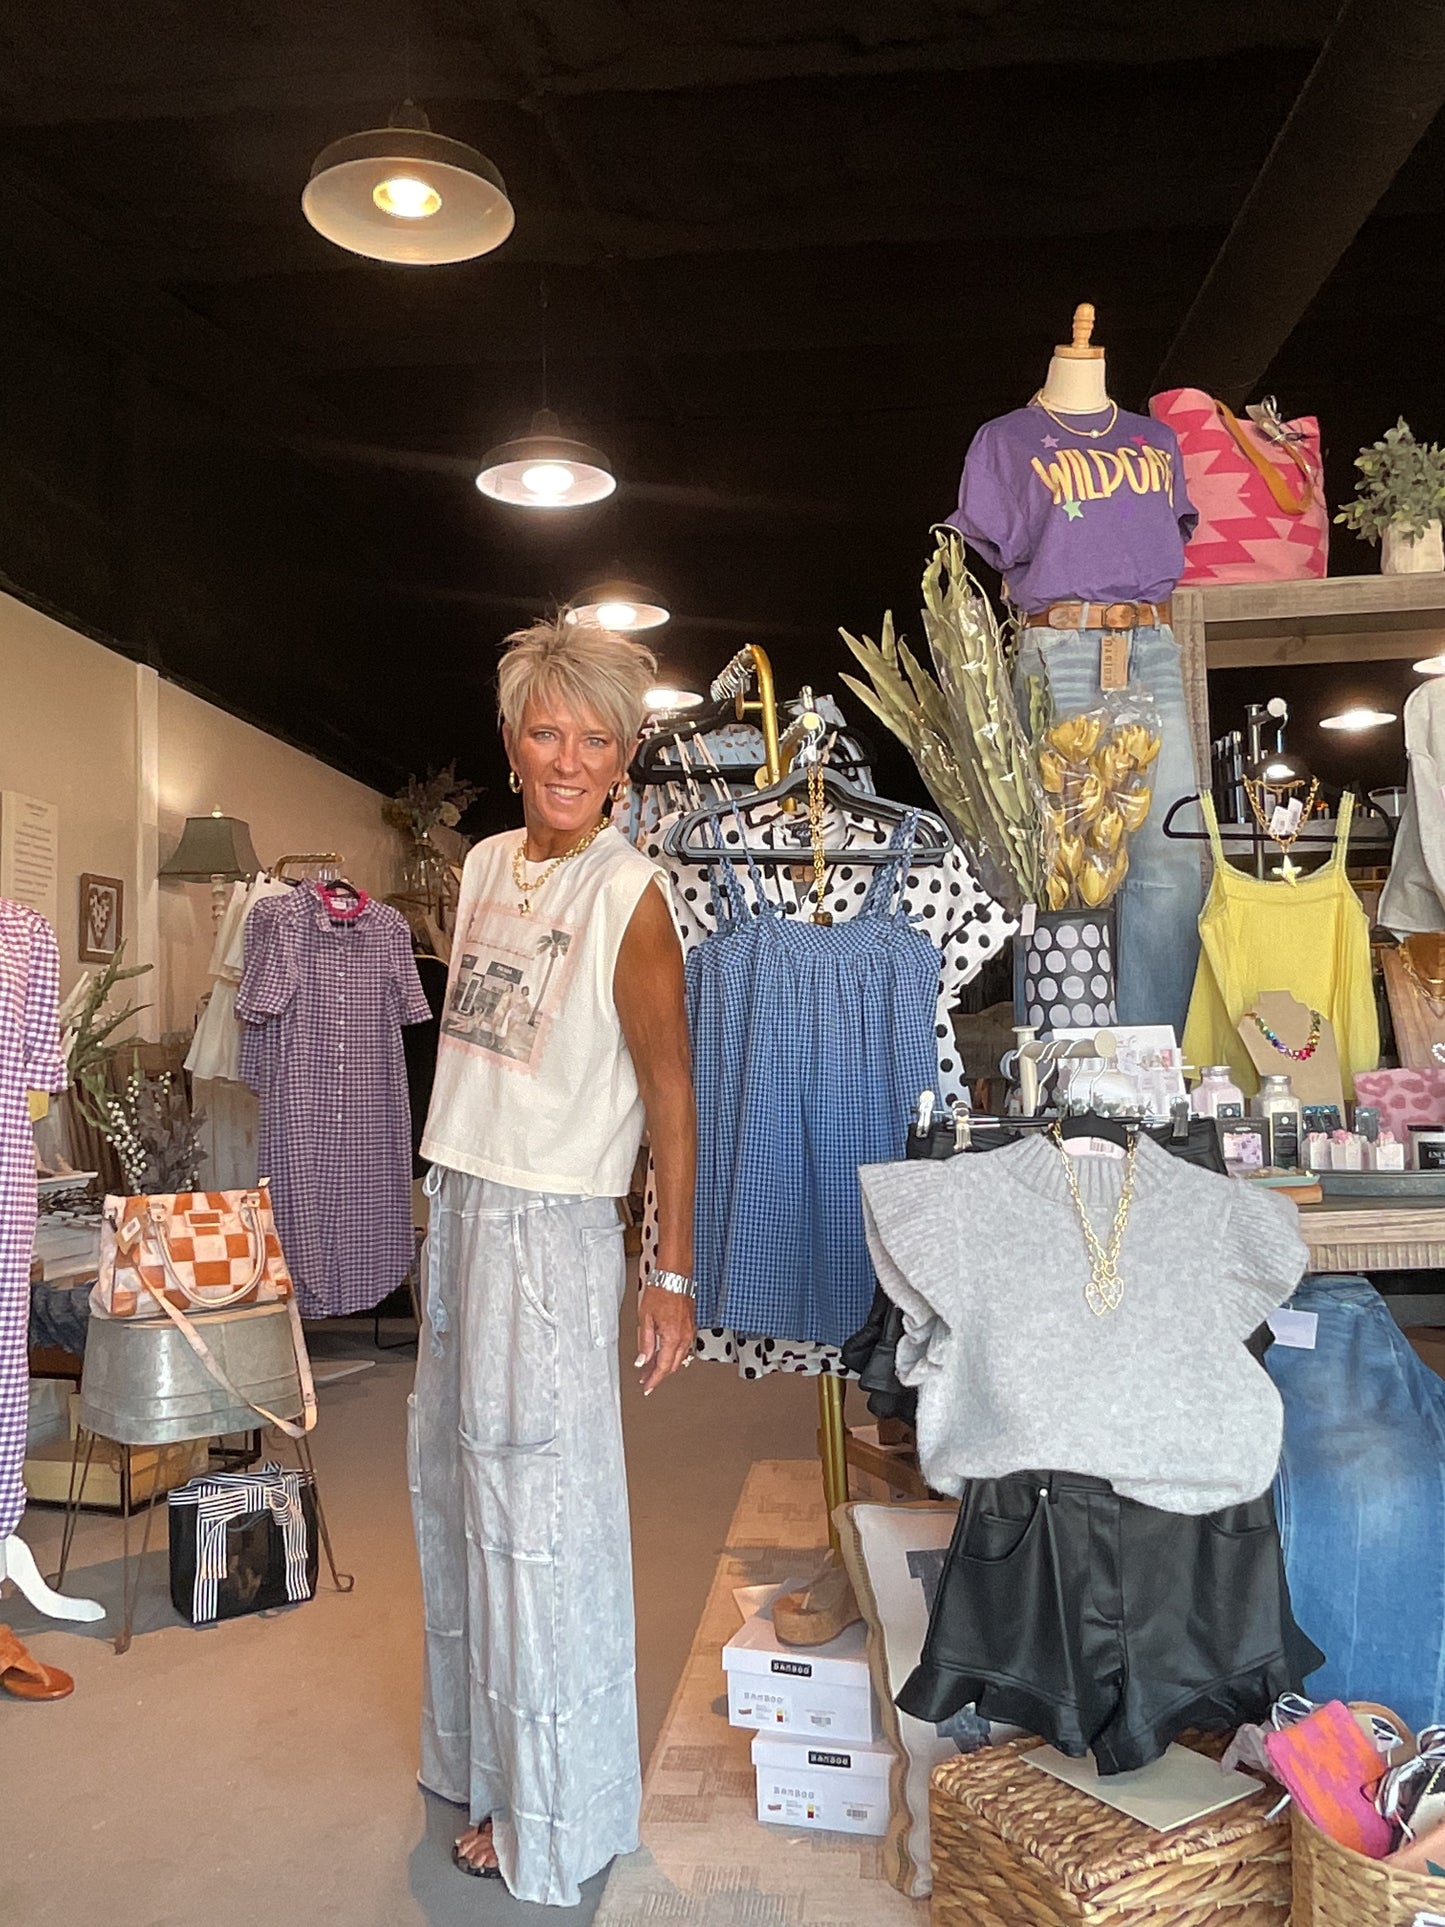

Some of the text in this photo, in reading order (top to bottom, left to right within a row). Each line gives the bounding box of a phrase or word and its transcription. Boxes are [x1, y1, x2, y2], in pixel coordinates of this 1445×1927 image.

[773, 1662, 810, 1675] BAMBOO
[744, 1692, 784, 1703] BAMBOO
[810, 1753, 848, 1765] BAMBOO
[773, 1786, 815, 1799] BAMBOO
